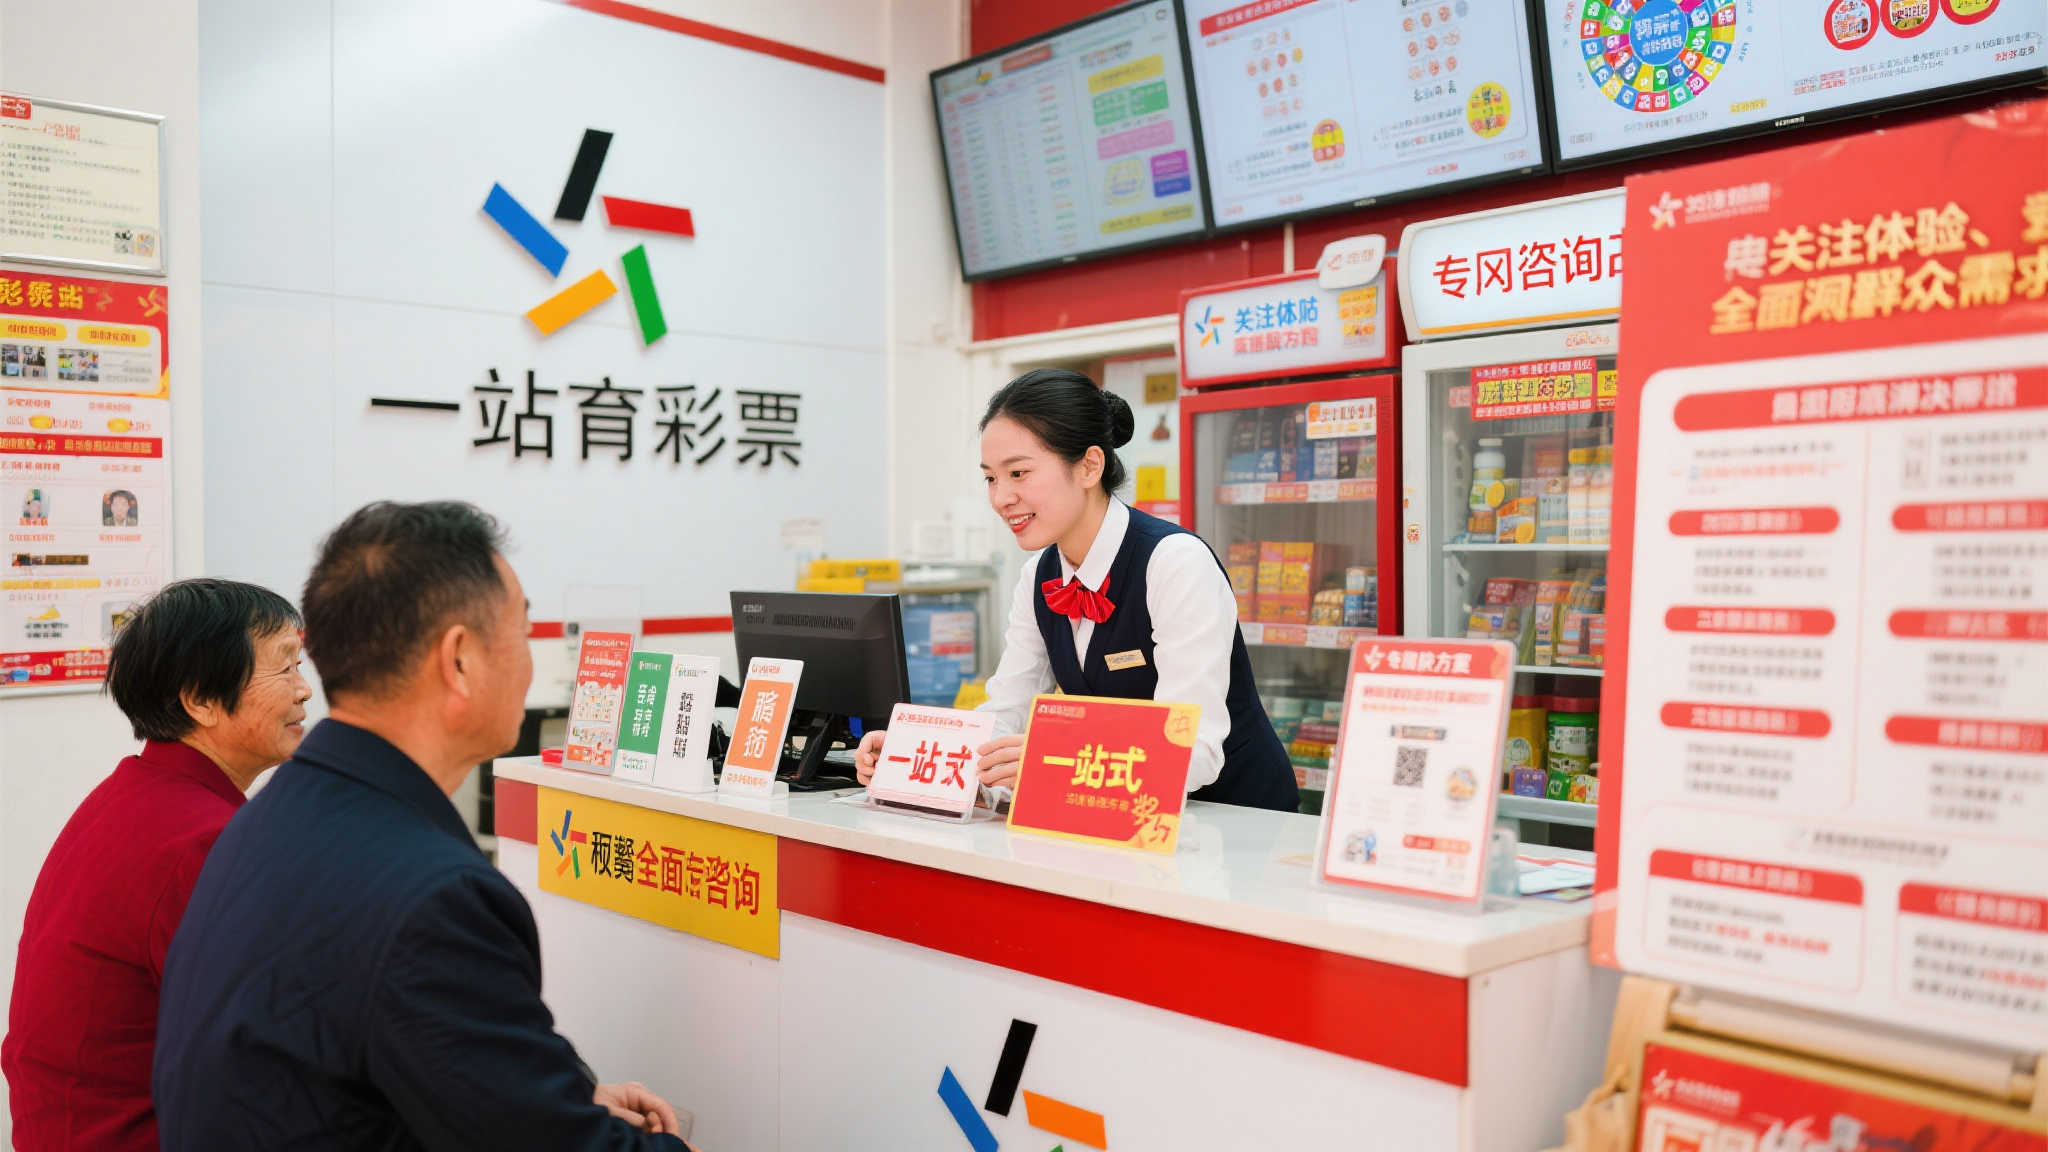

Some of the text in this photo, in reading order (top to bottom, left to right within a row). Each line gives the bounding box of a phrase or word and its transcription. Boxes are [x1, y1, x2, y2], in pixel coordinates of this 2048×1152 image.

[371, 368, 802, 467] 一站育彩票
[1043, 743, 1147, 793] 一站式
